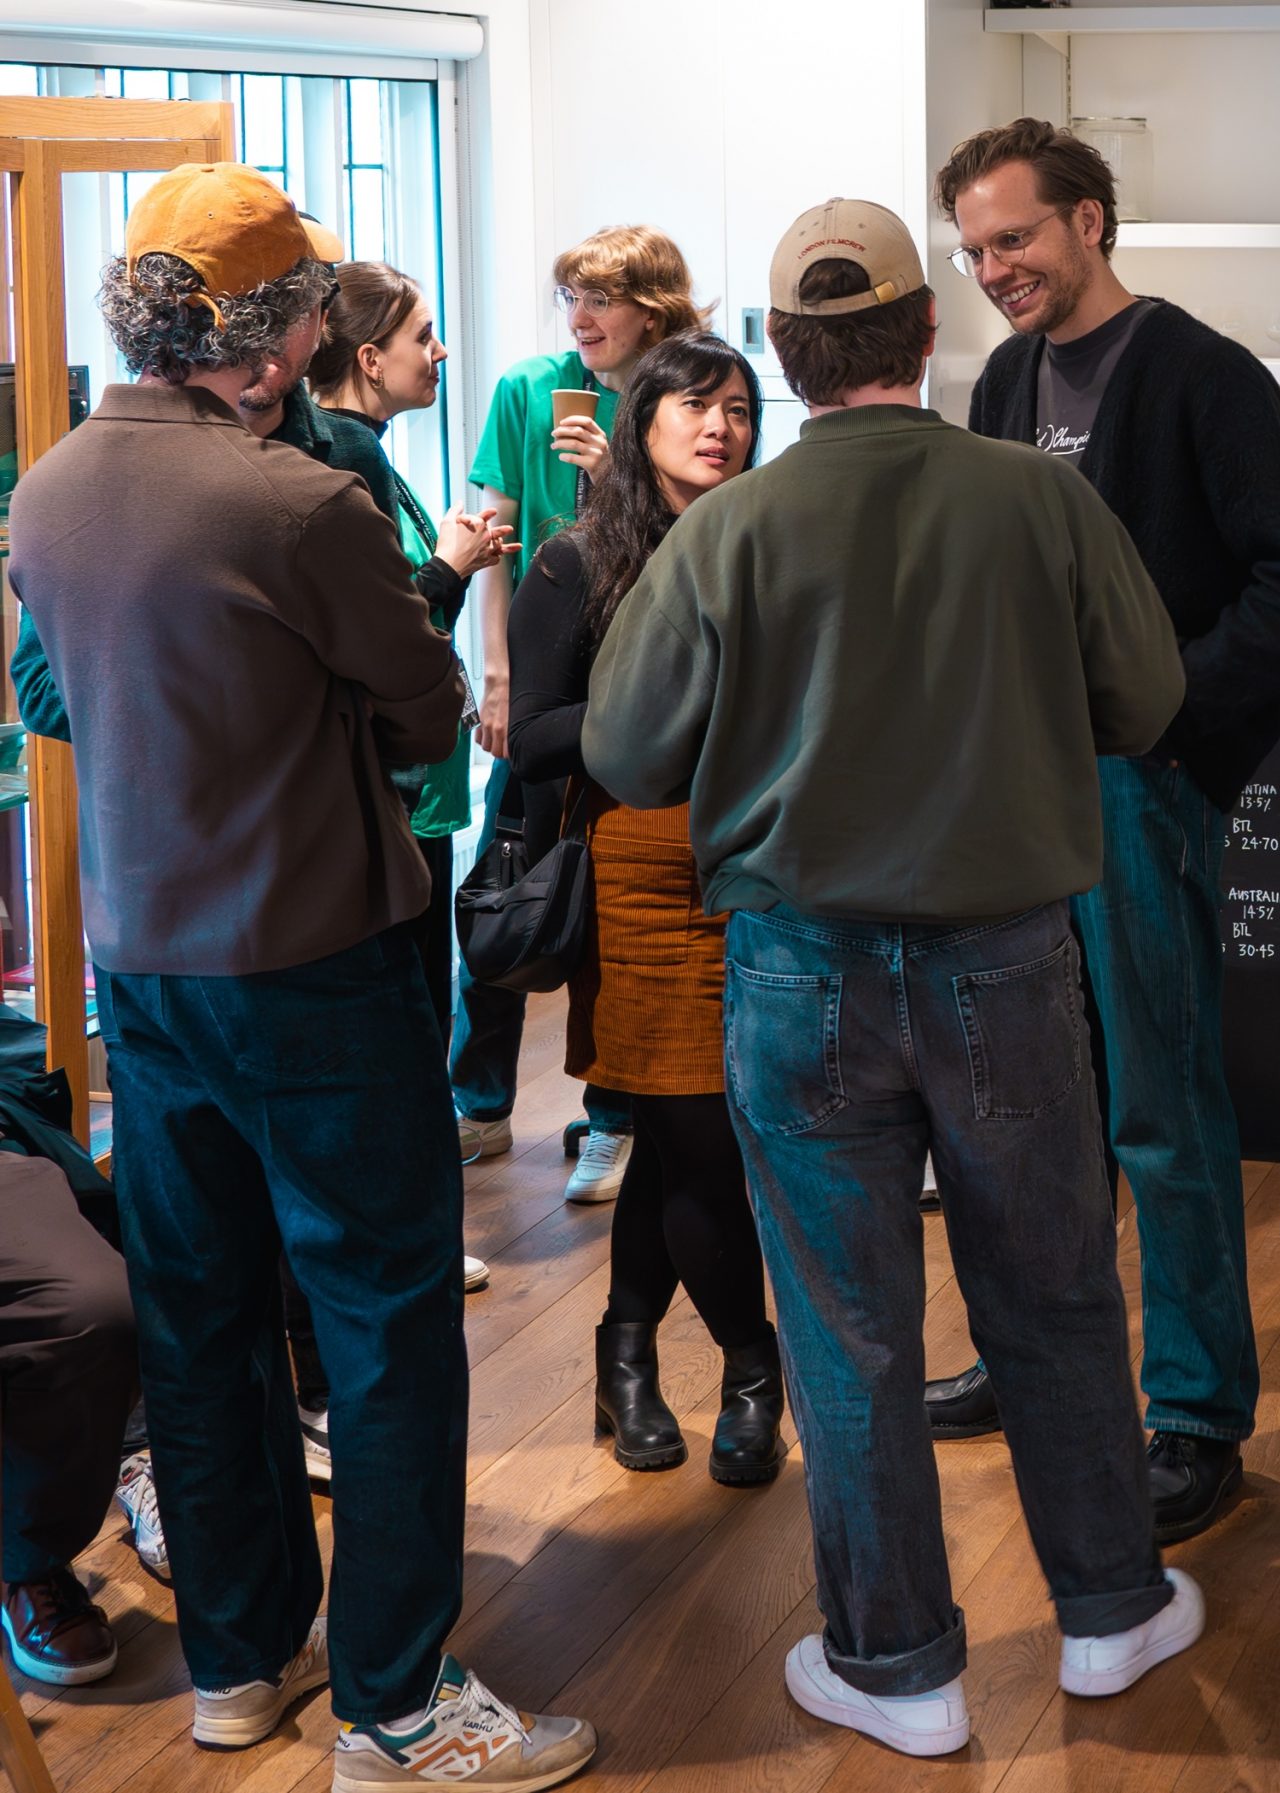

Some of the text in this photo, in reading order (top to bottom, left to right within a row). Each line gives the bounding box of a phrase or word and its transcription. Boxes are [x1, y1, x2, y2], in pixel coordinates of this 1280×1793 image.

[1241, 784, 1278, 796] NTINA
[1232, 818, 1253, 834] BTL
[1232, 922, 1252, 938] BTL
[462, 1719, 495, 1733] KARHU
